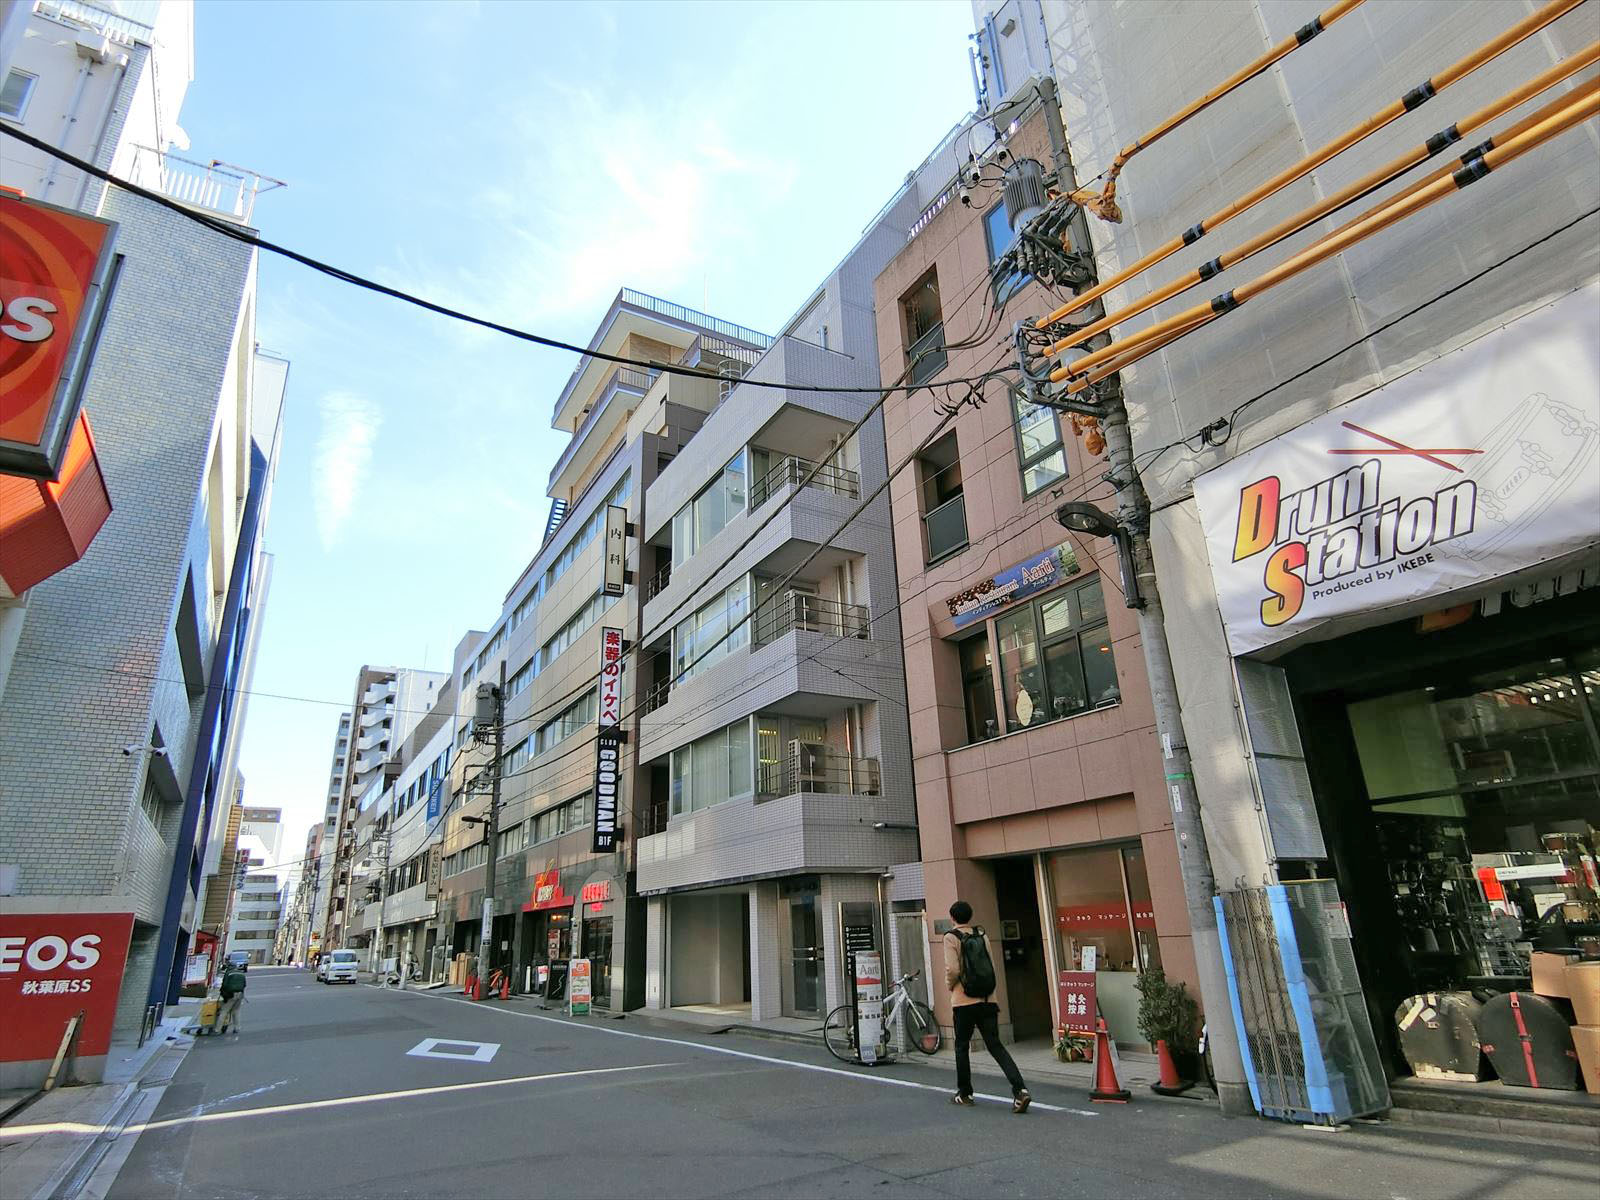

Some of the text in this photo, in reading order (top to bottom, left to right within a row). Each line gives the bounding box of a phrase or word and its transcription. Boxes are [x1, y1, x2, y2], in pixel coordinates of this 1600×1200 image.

[1232, 458, 1381, 563] Drum
[610, 527, 622, 565] 内科
[1260, 479, 1477, 628] Station
[956, 557, 1056, 616] Indian Restaurant Aarti
[1312, 553, 1436, 601] Produced by IKEBE
[603, 631, 621, 722] 楽器のイケベ
[600, 738, 617, 746] CLUB
[597, 749, 617, 832] GOODMAN
[21, 979, 92, 996] 秋葉原SS
